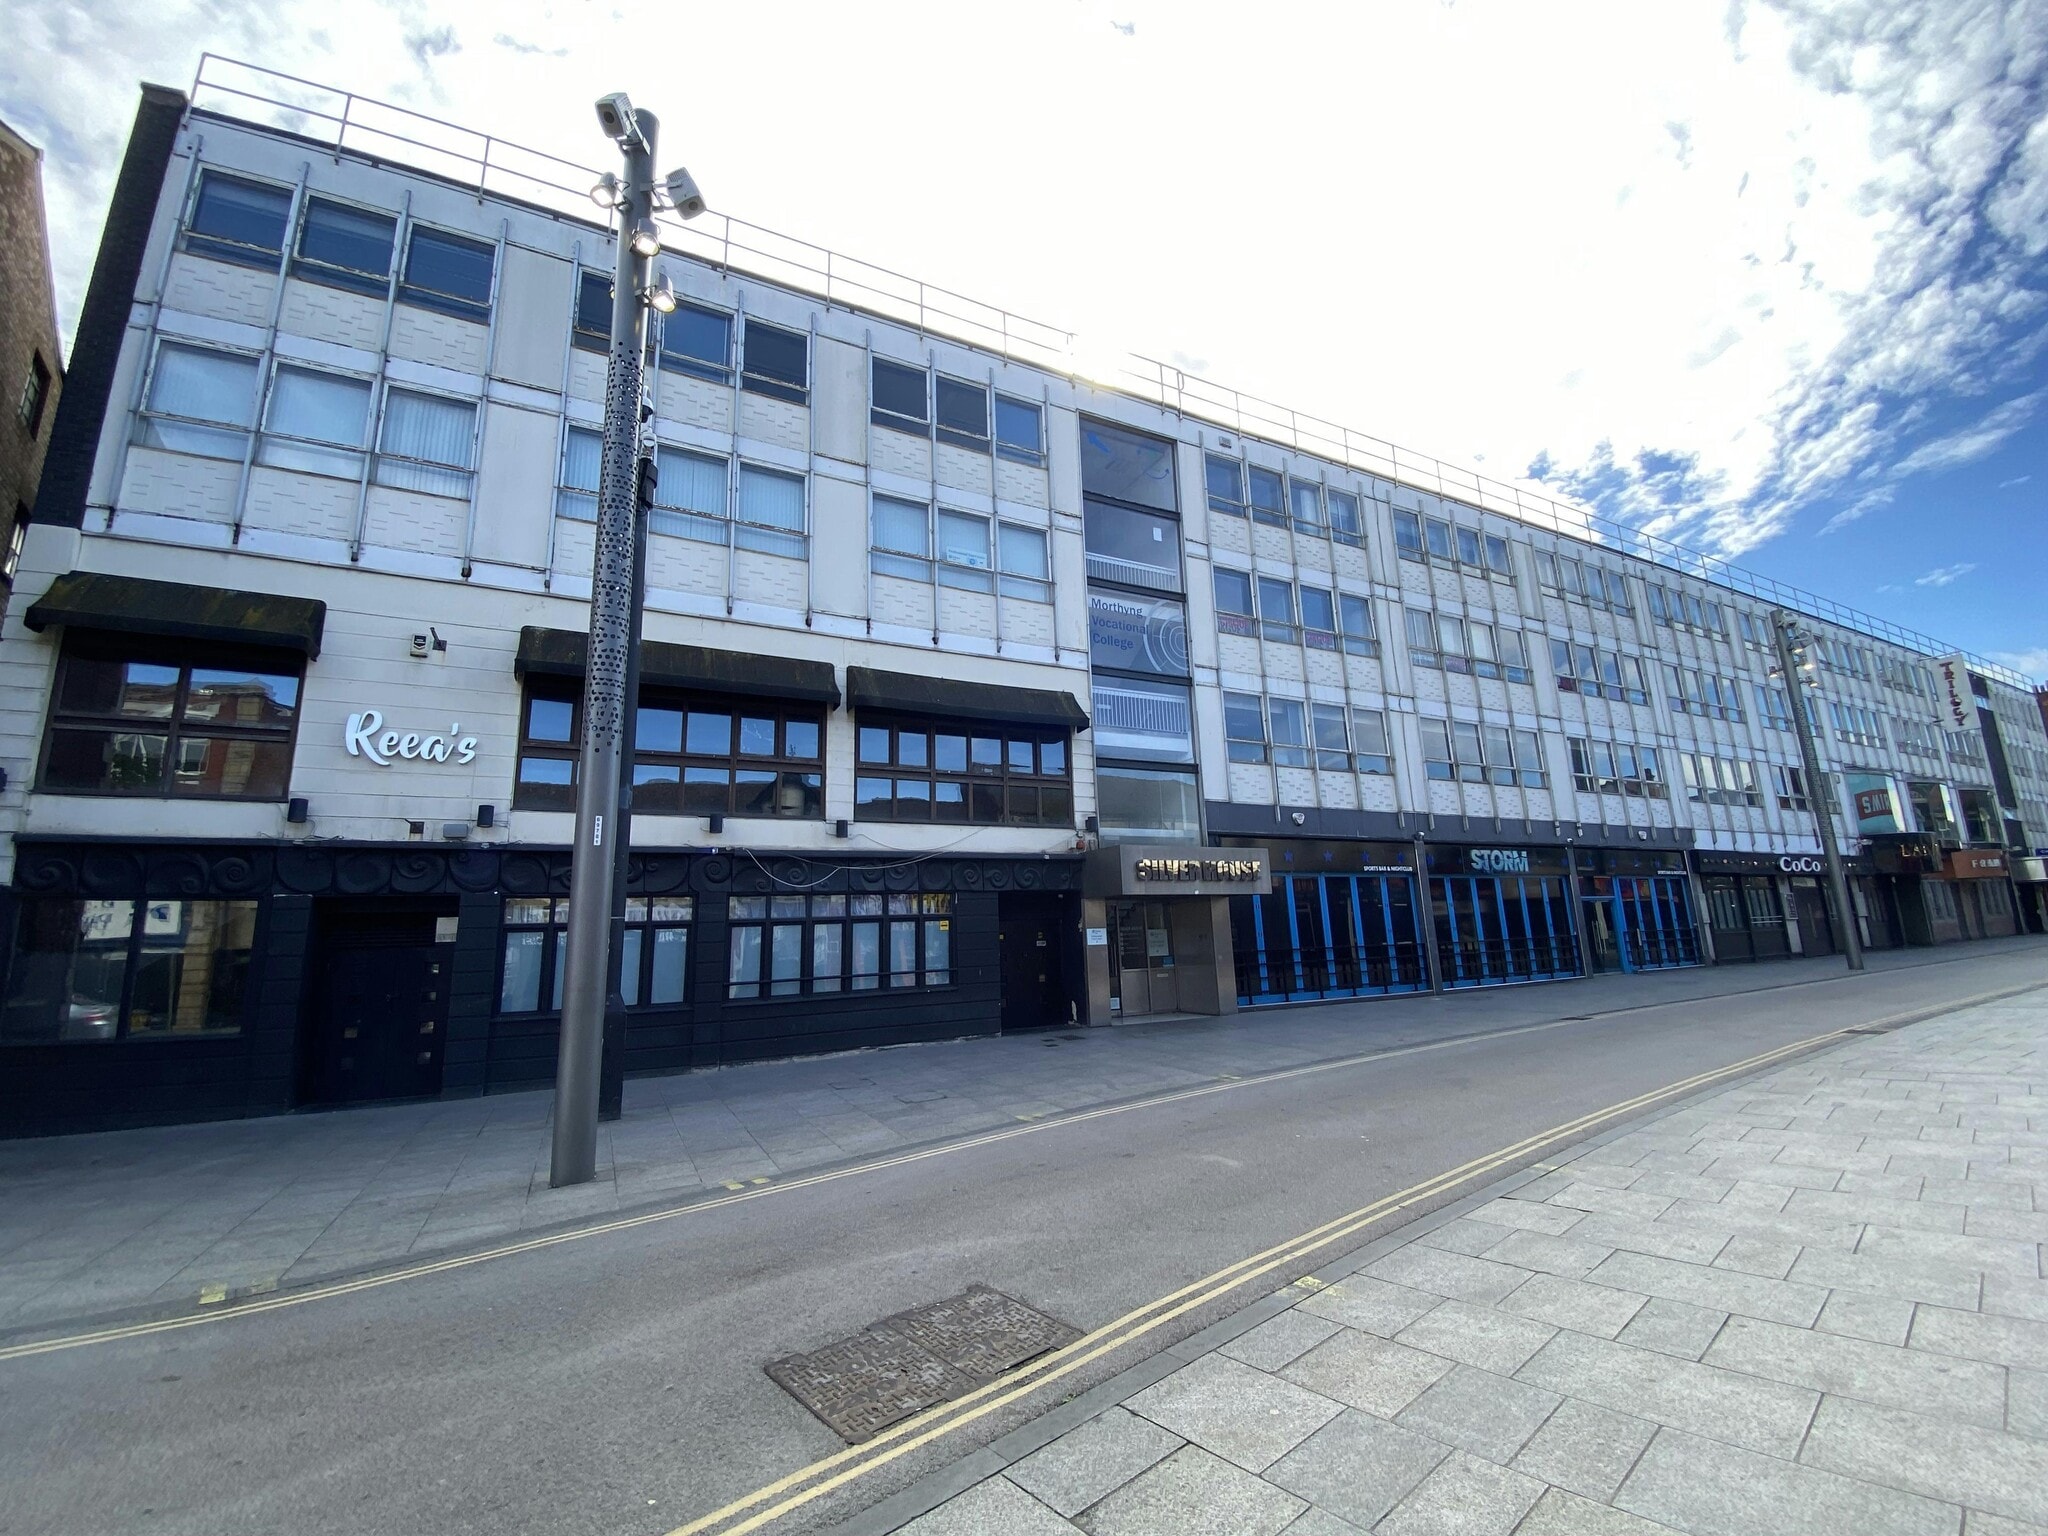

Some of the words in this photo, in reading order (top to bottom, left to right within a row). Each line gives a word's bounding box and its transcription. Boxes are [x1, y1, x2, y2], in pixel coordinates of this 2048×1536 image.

[1091, 597, 1143, 618] Morthyng
[1091, 615, 1149, 635] Vocational
[1092, 633, 1134, 651] College
[1939, 661, 1969, 726] TRILOGY
[344, 710, 478, 766] Reea's
[1136, 858, 1200, 881] SILVER
[1201, 860, 1261, 881] HOUSE
[1470, 849, 1529, 872] STORM
[1779, 856, 1821, 872] CoCo
